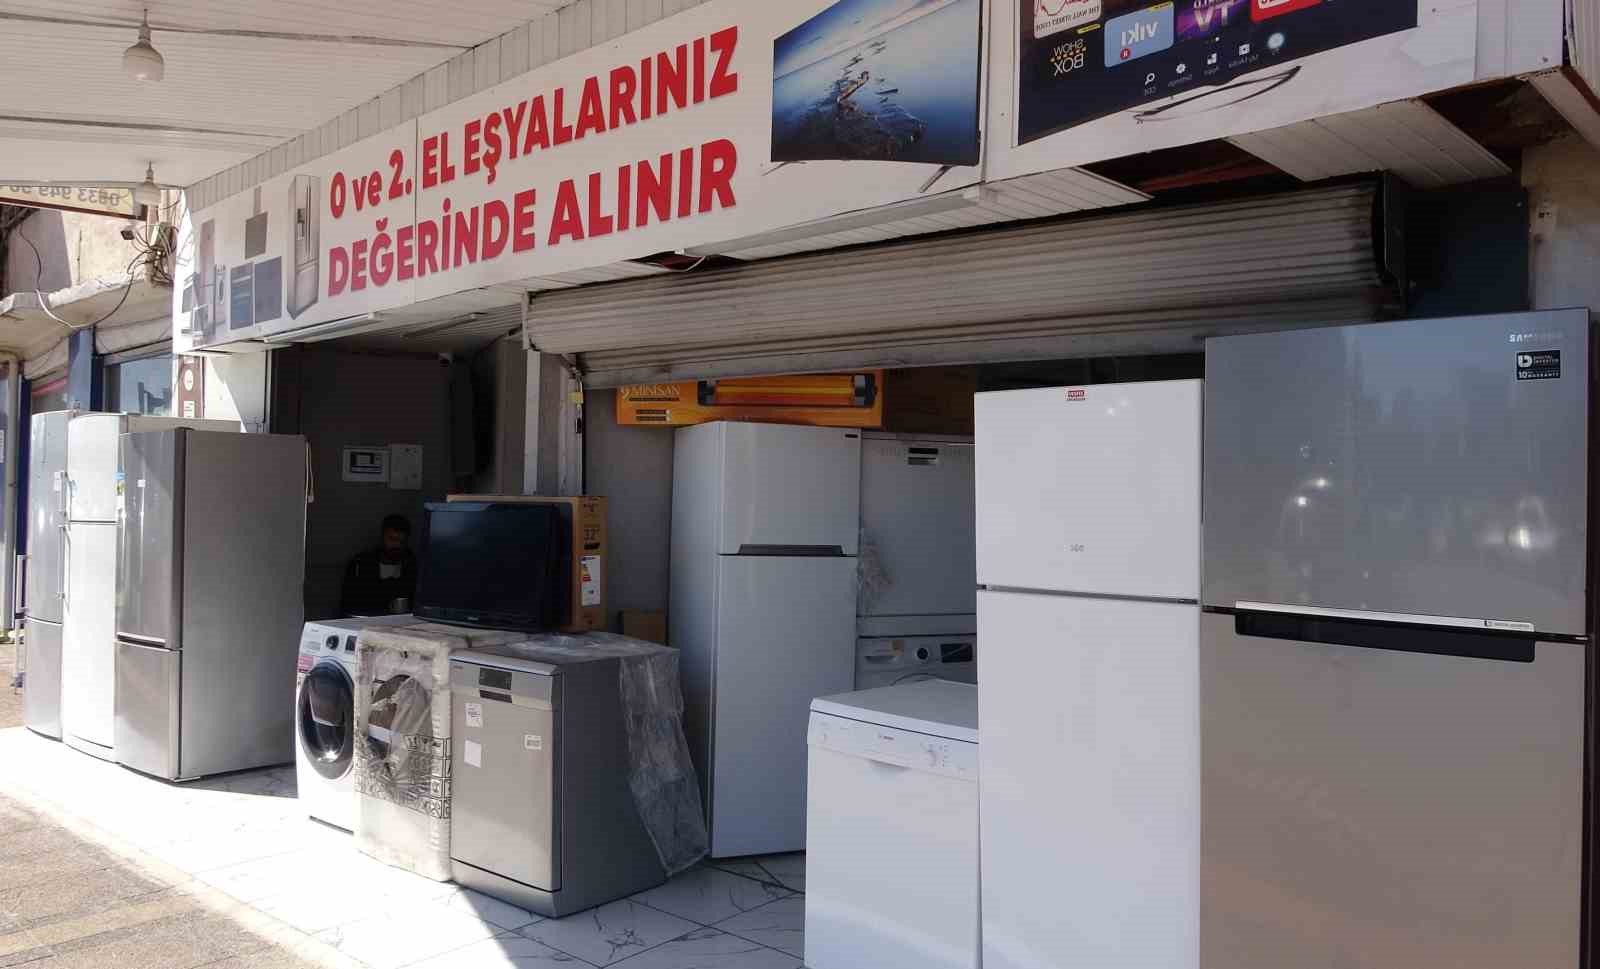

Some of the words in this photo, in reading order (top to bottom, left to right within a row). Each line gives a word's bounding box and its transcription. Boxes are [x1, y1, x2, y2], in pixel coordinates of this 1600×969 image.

[352, 169, 383, 209] ve
[388, 150, 413, 199] 2.
[422, 133, 456, 189] EL
[463, 26, 738, 184] EŞYALARINIZ
[328, 189, 536, 296] DEĞERİNDE
[548, 139, 737, 246] ALINIR
